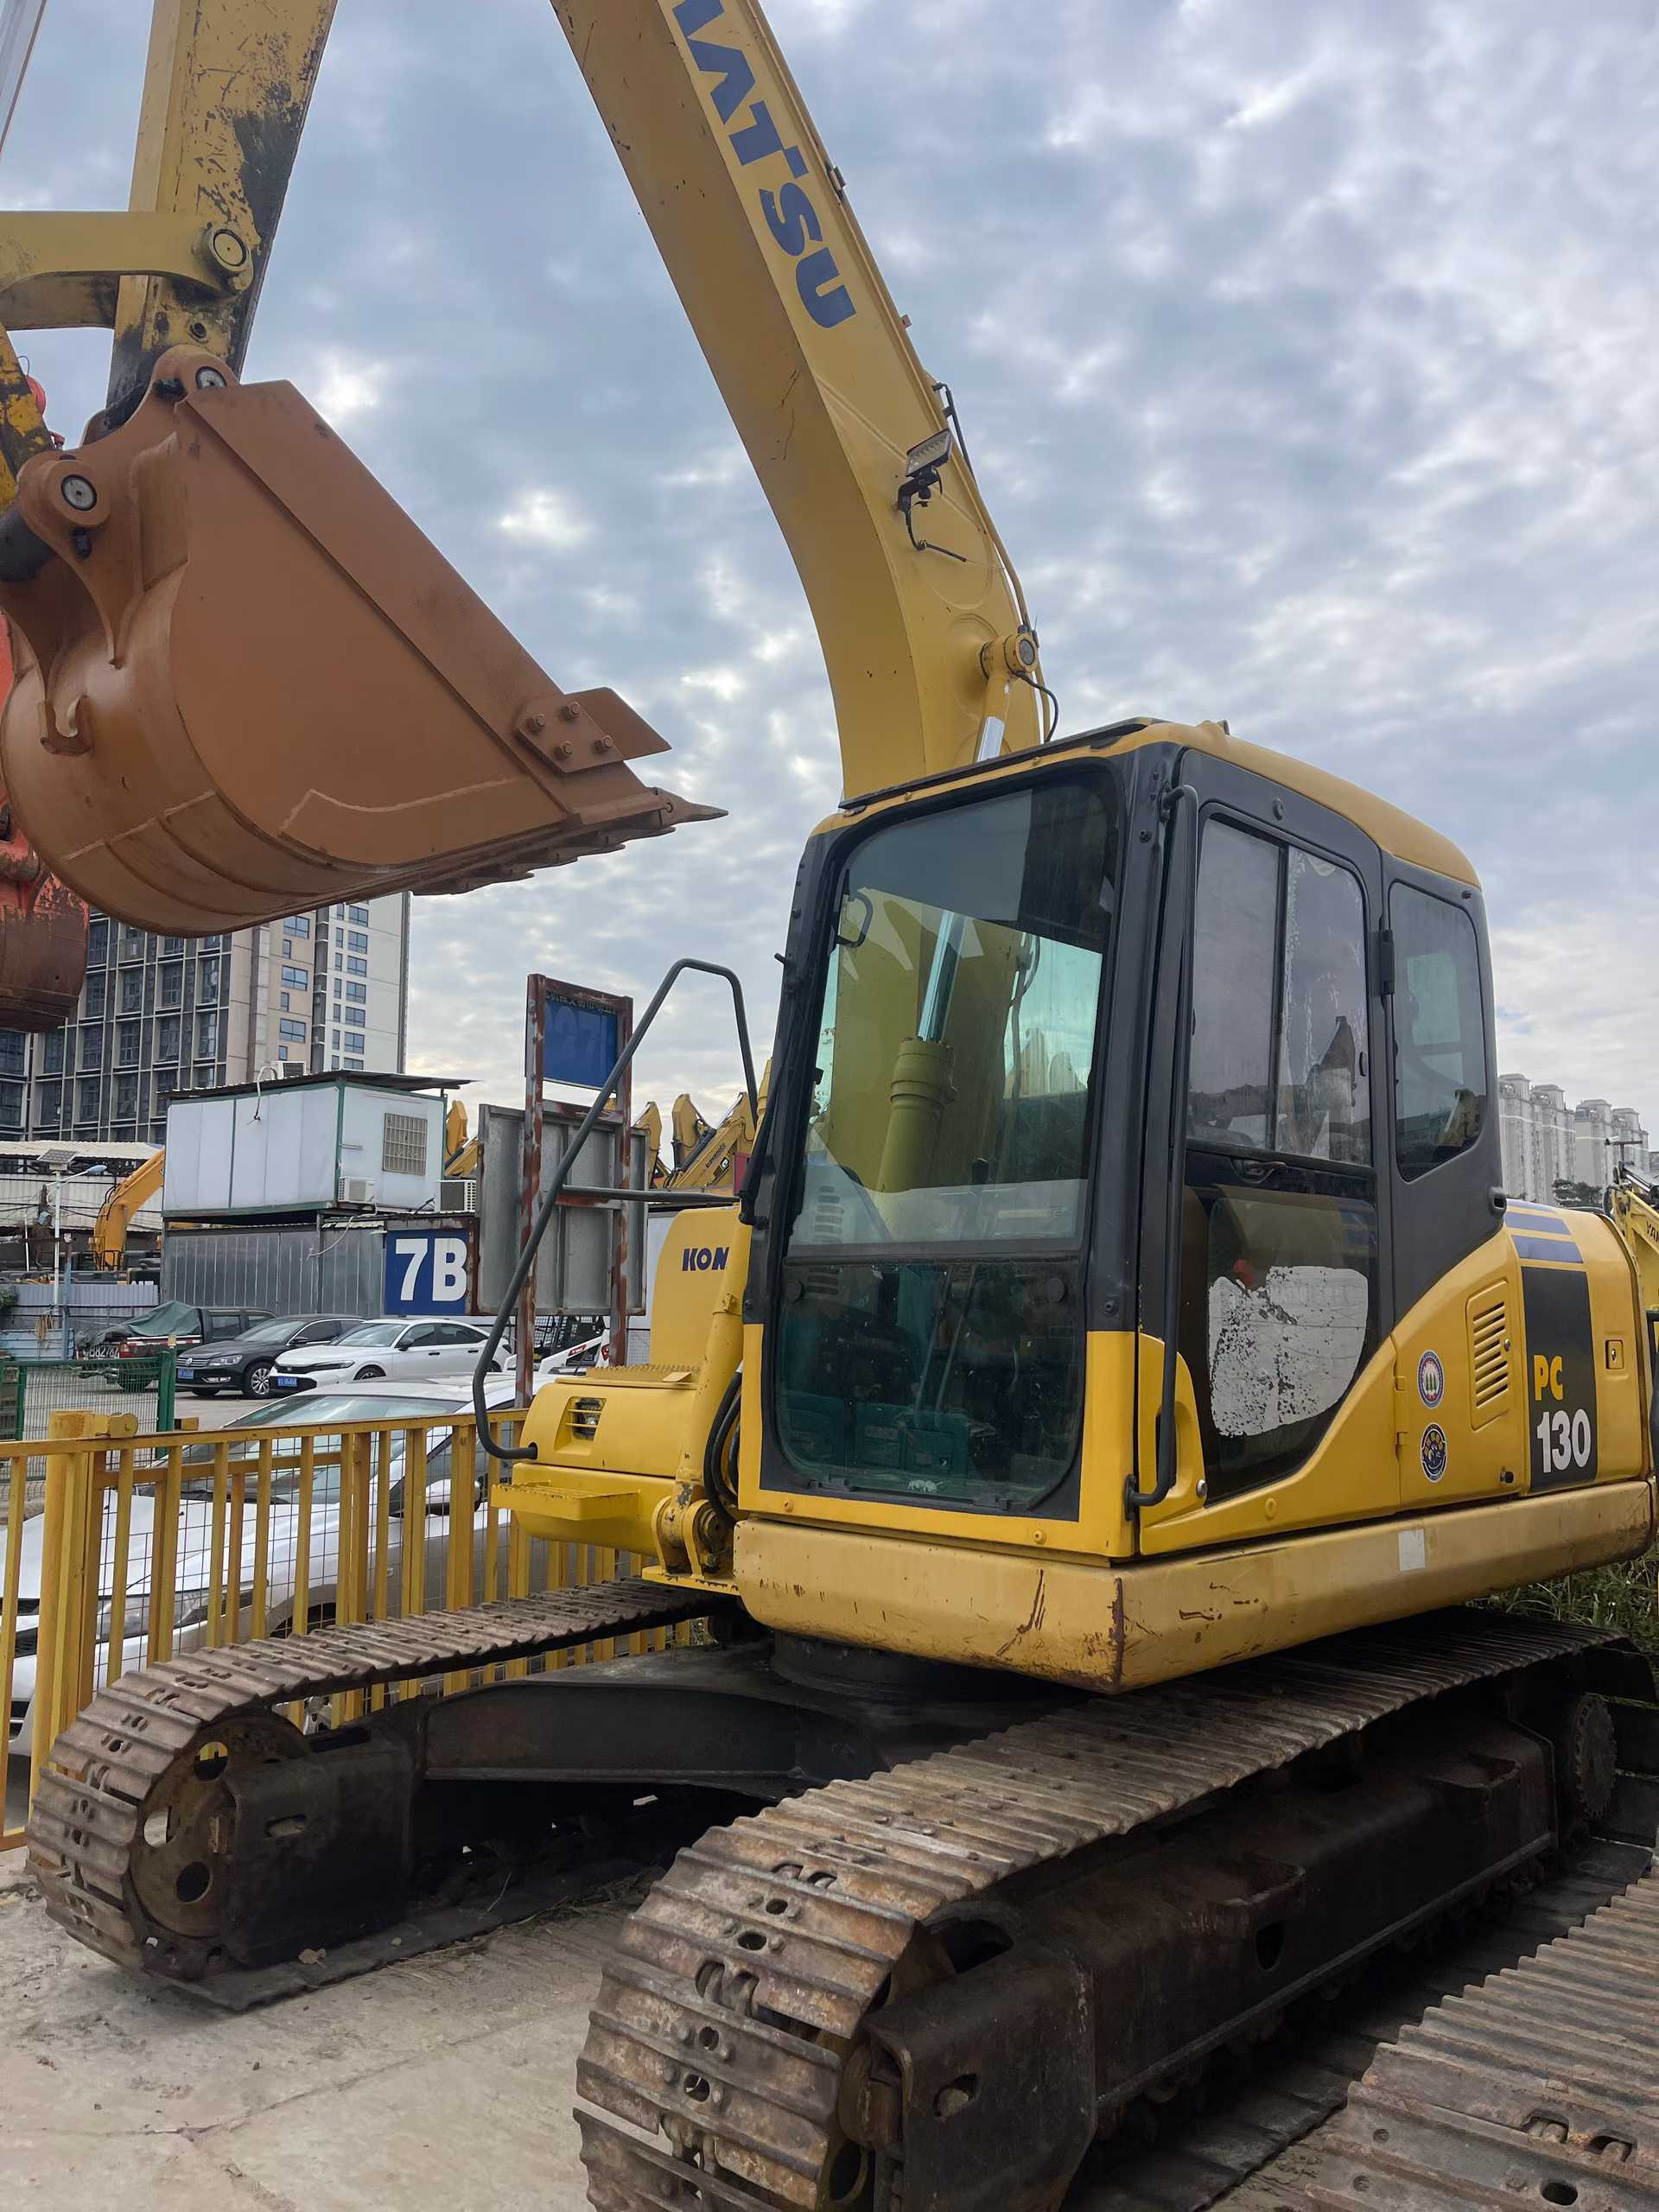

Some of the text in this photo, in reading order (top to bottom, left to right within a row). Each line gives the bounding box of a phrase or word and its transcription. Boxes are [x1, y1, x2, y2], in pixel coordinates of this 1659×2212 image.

[672, 0, 857, 328] ATSU
[395, 1237, 467, 1301] 7B
[1534, 1355, 1563, 1401] PC
[1537, 1408, 1591, 1473] 130
